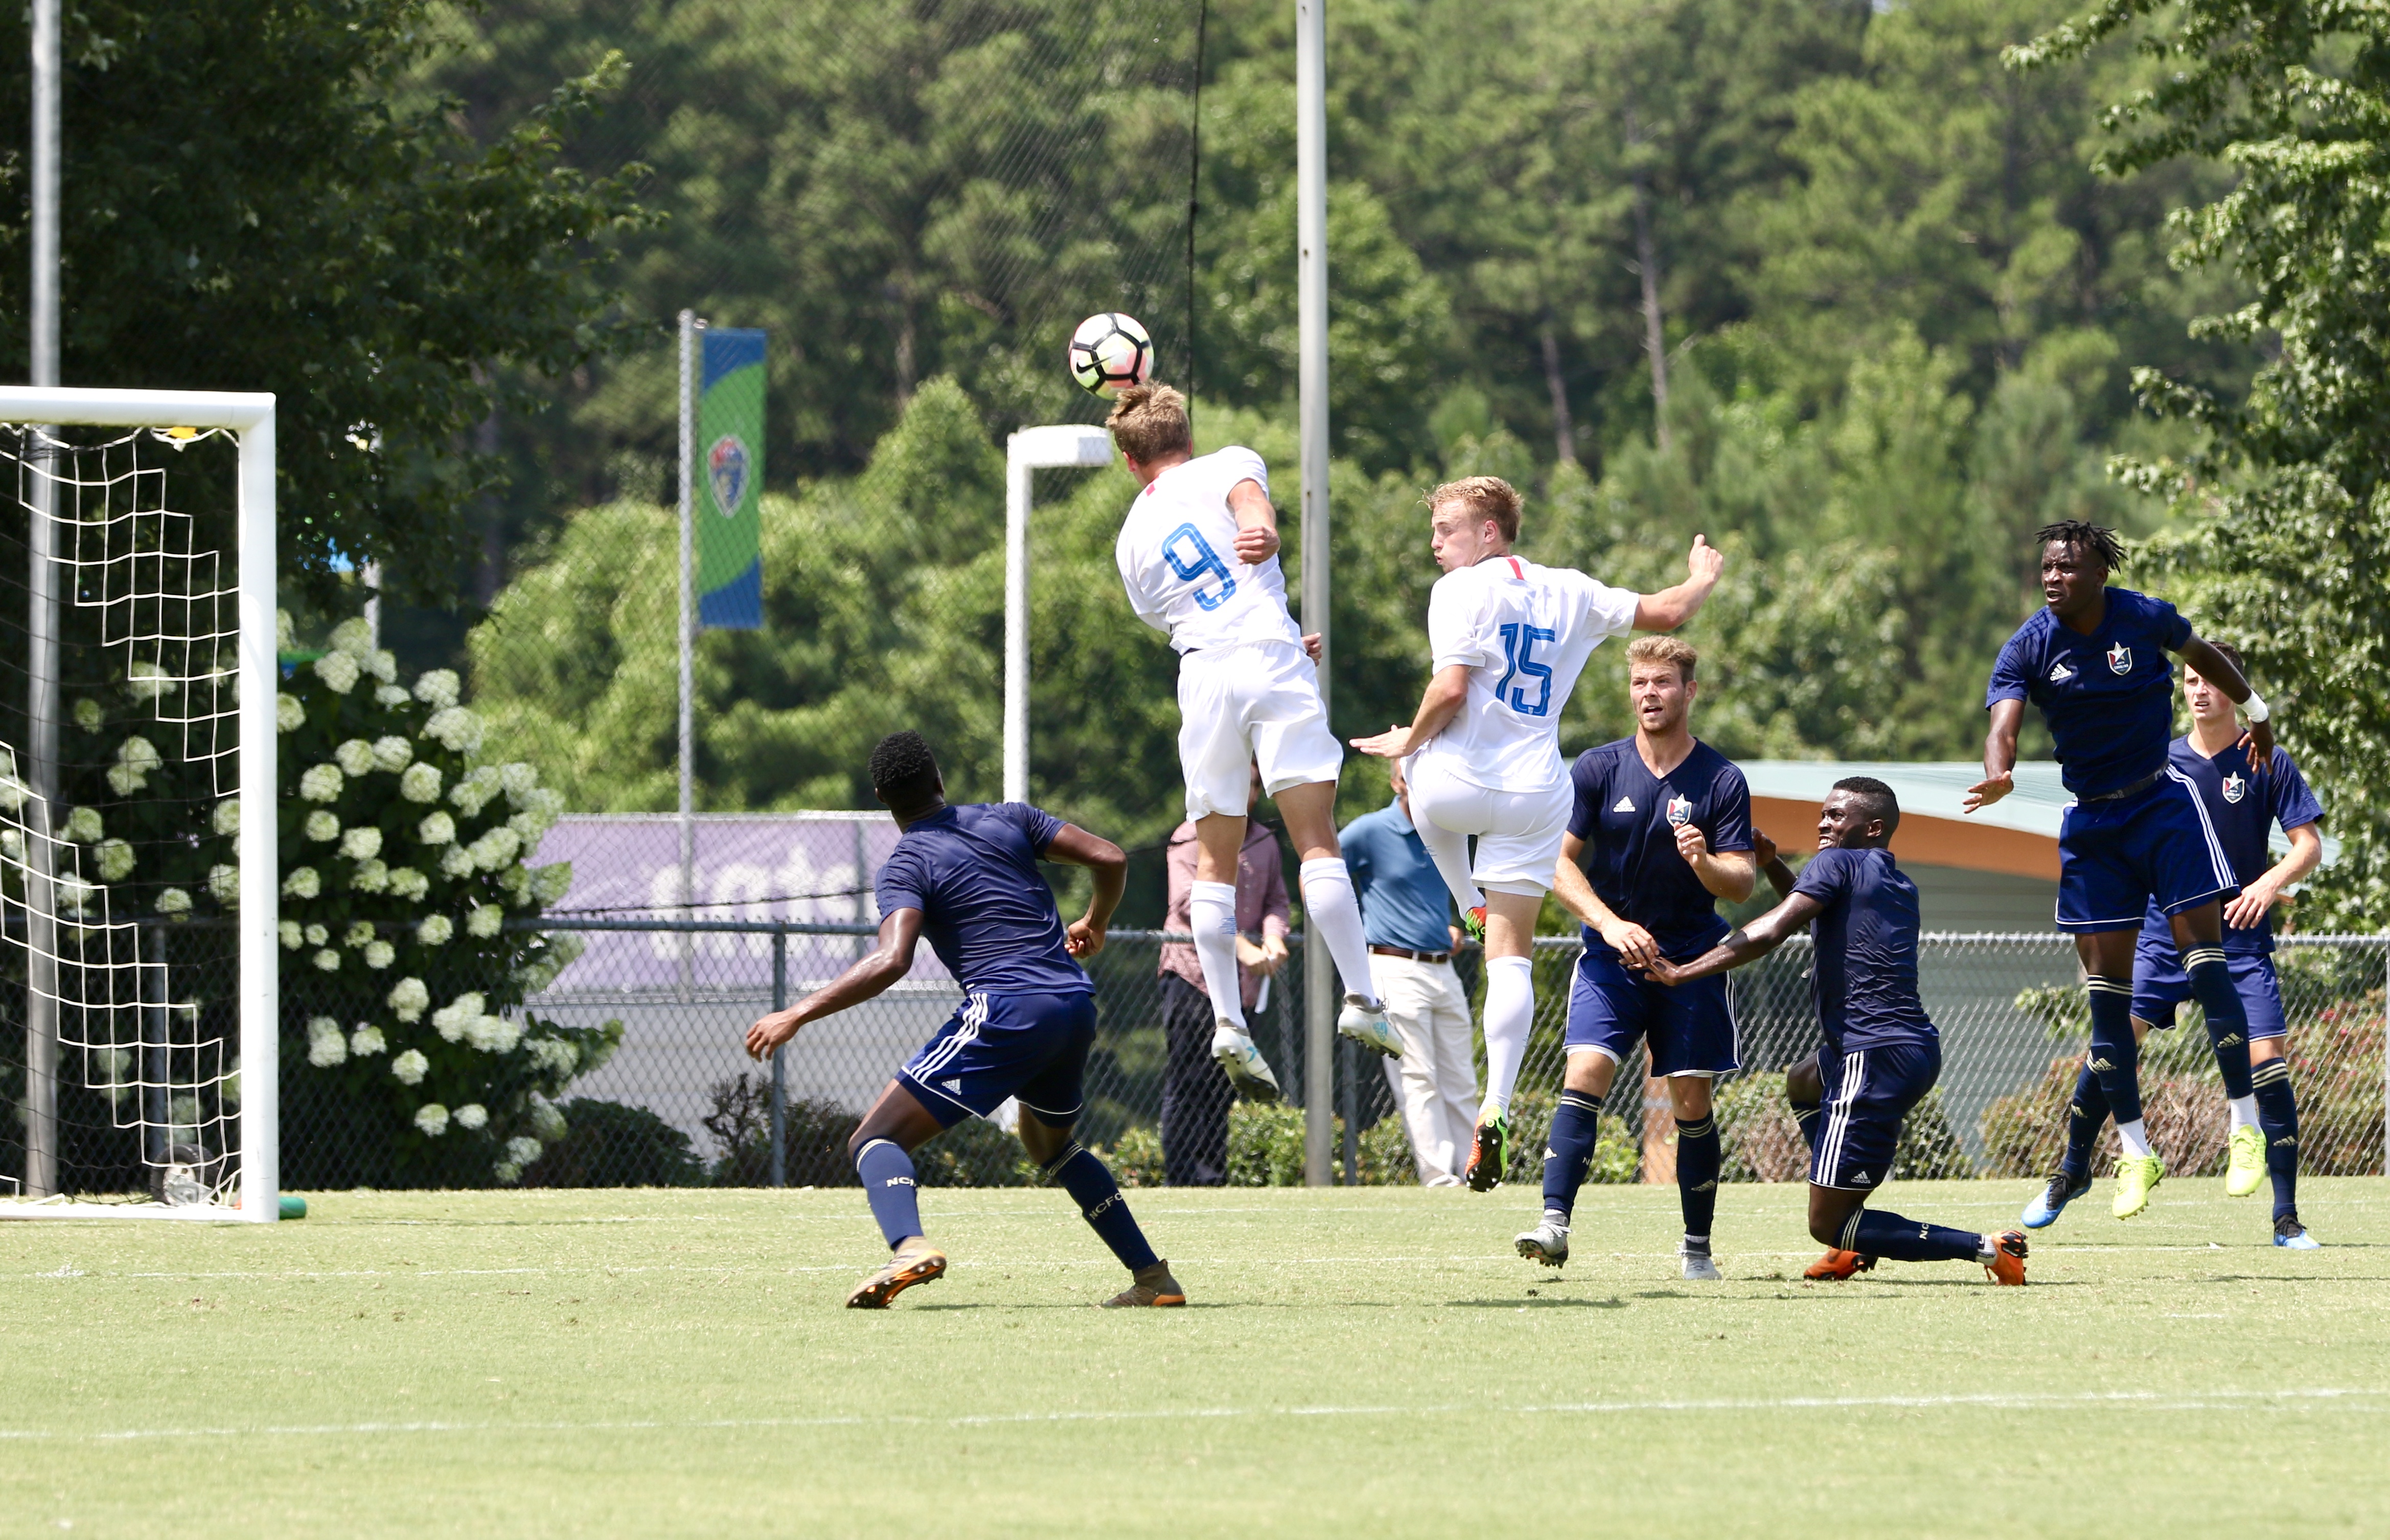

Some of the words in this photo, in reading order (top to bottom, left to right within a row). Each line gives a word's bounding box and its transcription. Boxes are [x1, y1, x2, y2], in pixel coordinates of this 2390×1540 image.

[1161, 522, 1236, 612] 9
[1496, 623, 1555, 717] 15
[941, 1082, 962, 1095] adidas
[1089, 1192, 1122, 1220] NCFC
